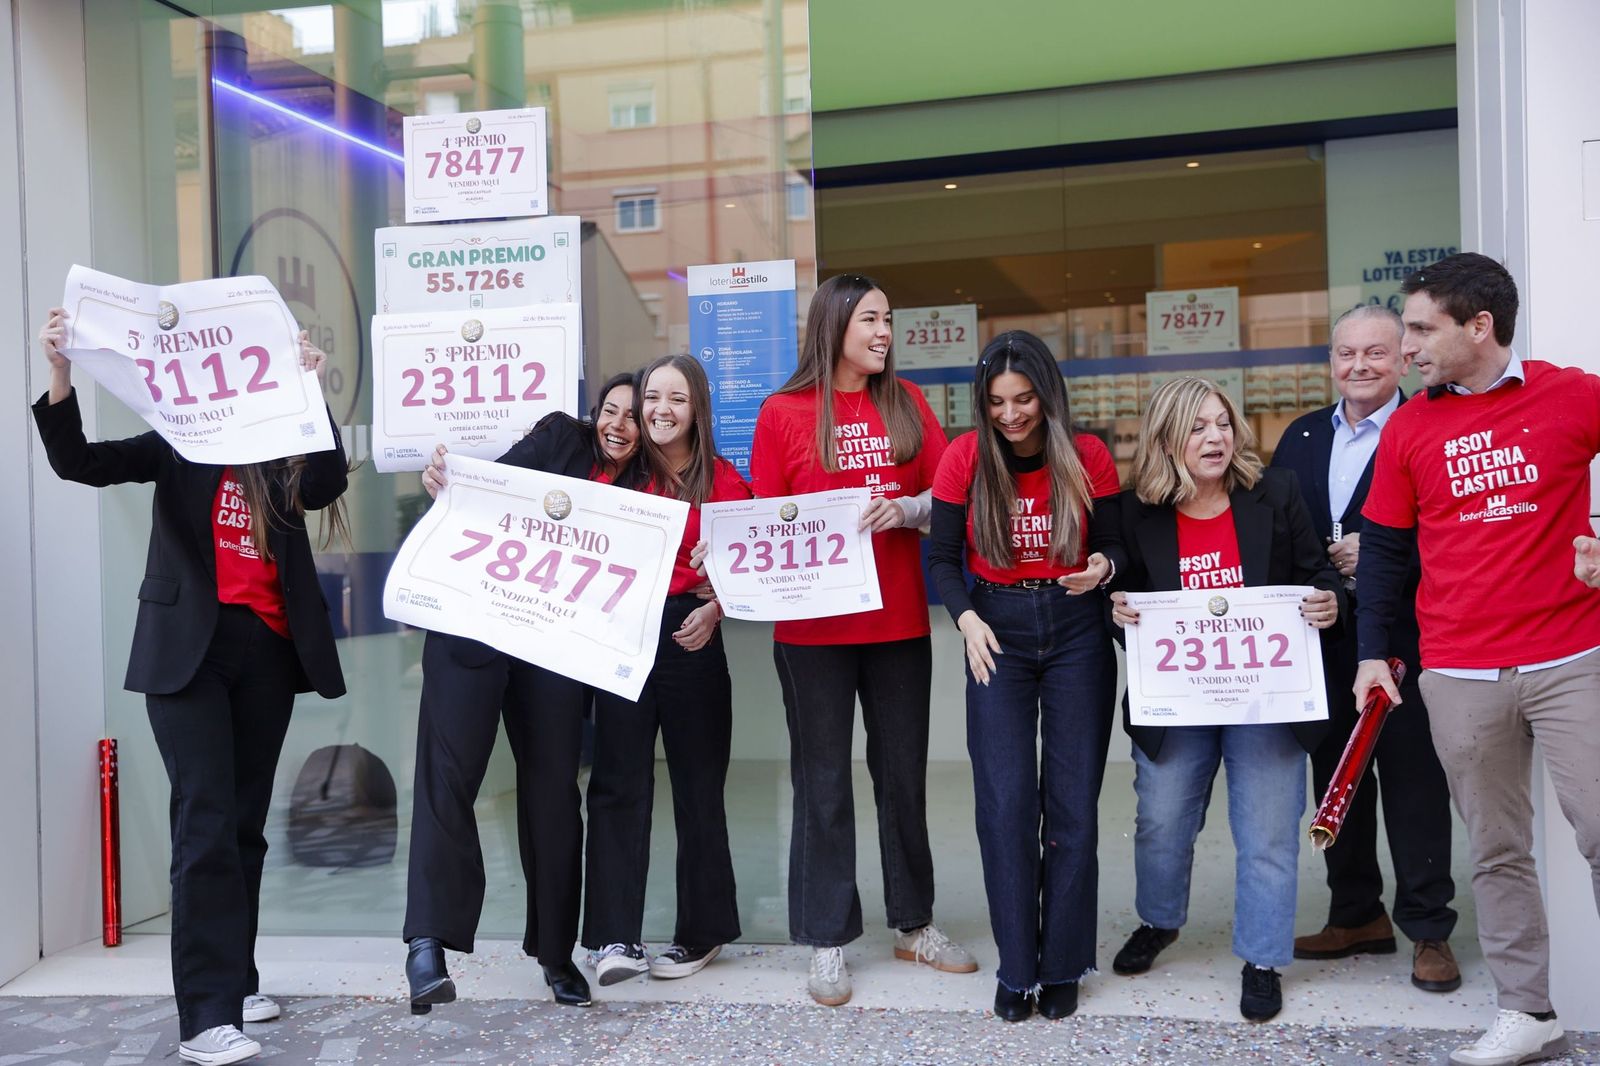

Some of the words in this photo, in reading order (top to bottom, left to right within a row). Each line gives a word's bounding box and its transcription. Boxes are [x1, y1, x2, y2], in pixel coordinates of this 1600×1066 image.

[455, 133, 506, 147] PREMIO
[425, 147, 525, 179] 78477
[448, 180, 480, 188] VENDIDO
[408, 249, 465, 269] GRAN
[469, 244, 546, 265] PREMIO
[1384, 250, 1403, 264] YA
[426, 268, 525, 293] 55.726€
[1161, 310, 1225, 330] 78477
[906, 326, 965, 346] 23112
[446, 343, 521, 362] PREMIO
[135, 345, 279, 406] 3112
[401, 362, 547, 407] 23112
[160, 411, 197, 425] NDIDO
[435, 411, 480, 420] VENDIDO
[187, 426, 222, 437] CASTILLO
[833, 422, 869, 439] #SOY
[836, 436, 892, 455] LOTERIA
[1444, 430, 1493, 458] #SOY
[838, 452, 896, 471] CASTILL
[1446, 445, 1526, 478] LOTERIA
[223, 480, 244, 496] #S
[870, 482, 901, 493] castillo
[1450, 464, 1539, 498] CASTILLO
[1016, 498, 1035, 514] OY
[1459, 502, 1538, 522] loteriacastillo
[498, 513, 517, 532] 4º
[521, 517, 610, 555] PREMIO
[766, 519, 826, 538] PREMIO
[220, 538, 260, 556] loteriacas
[728, 533, 849, 574] 23112
[449, 529, 637, 614] 78477
[1179, 551, 1221, 573] #SOY
[759, 575, 796, 585] VENDIDO
[481, 580, 539, 605] VENDIDO
[409, 599, 442, 611] NACIONAL
[501, 611, 535, 625] ALAQUAS
[521, 608, 555, 624] CASTILLO
[1195, 617, 1265, 634] PREMIO
[1155, 633, 1293, 672] 23112
[1188, 676, 1232, 685] VENDIDO
